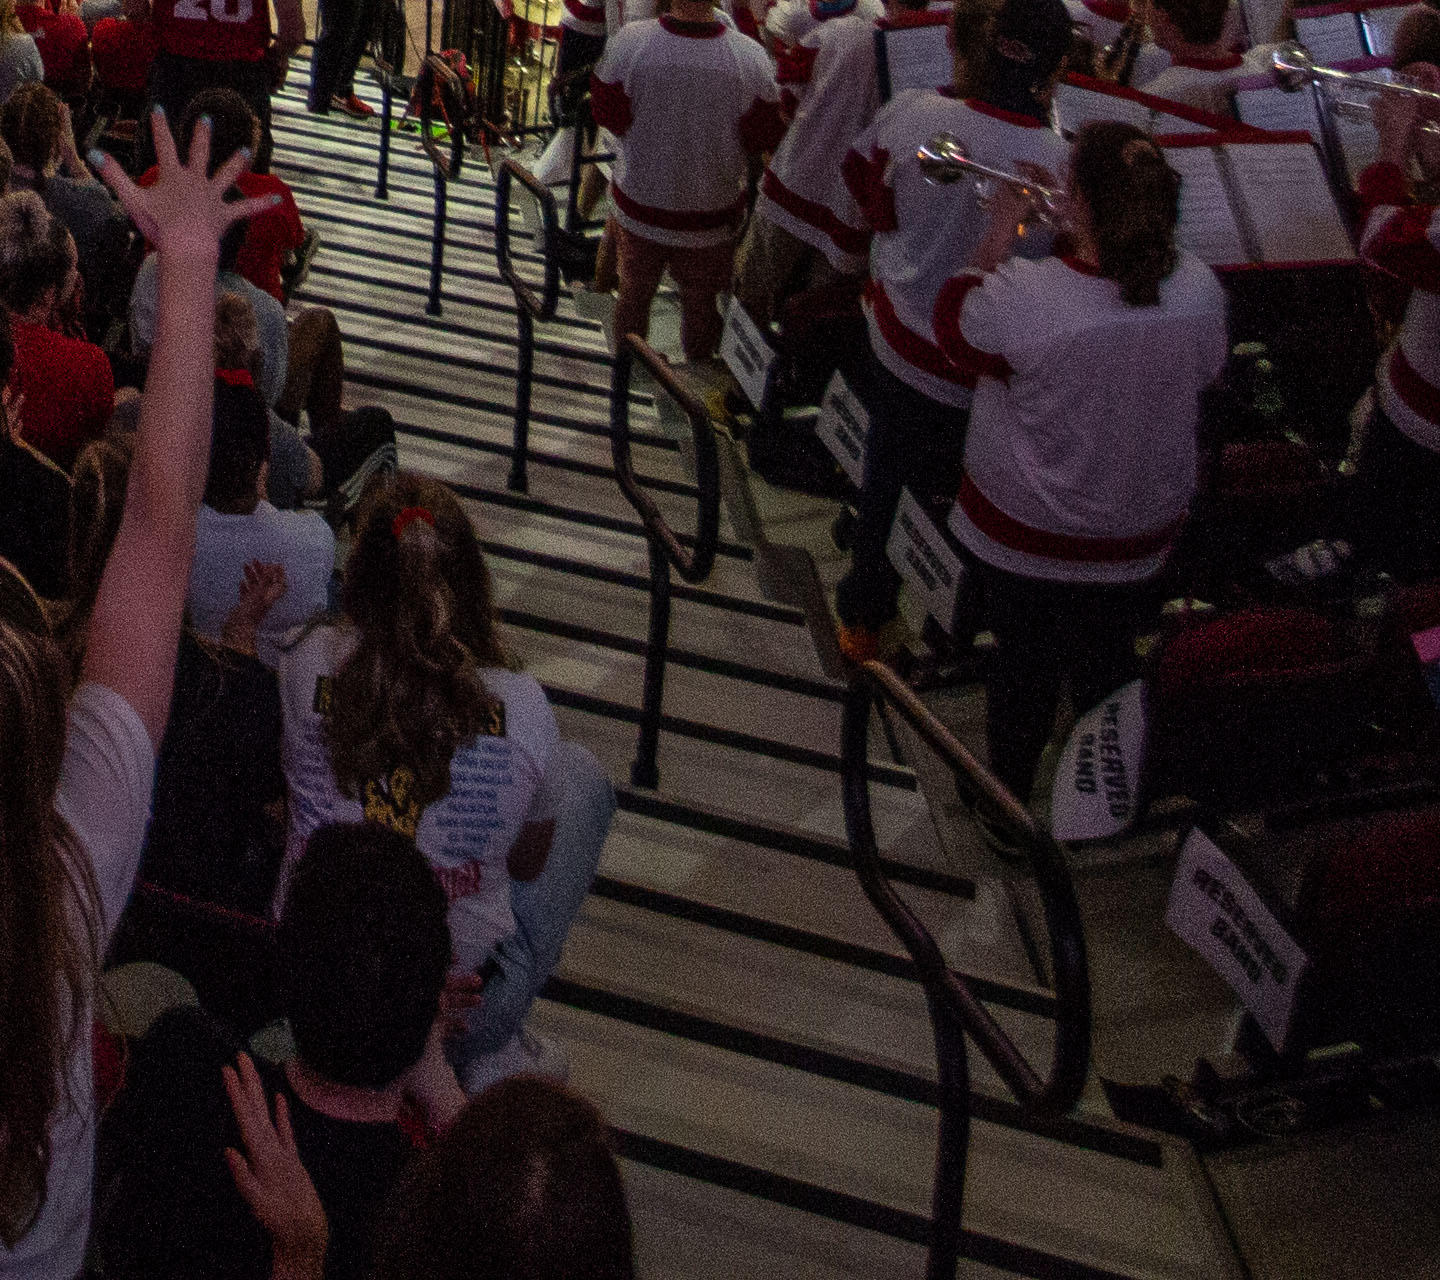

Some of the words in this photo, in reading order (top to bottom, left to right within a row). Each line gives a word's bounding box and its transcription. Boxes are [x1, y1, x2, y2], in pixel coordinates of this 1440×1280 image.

[1075, 733, 1097, 795] BAND
[1100, 701, 1129, 819] RESERVED
[1192, 867, 1287, 986] RESERVED
[1210, 917, 1262, 984] BAND
